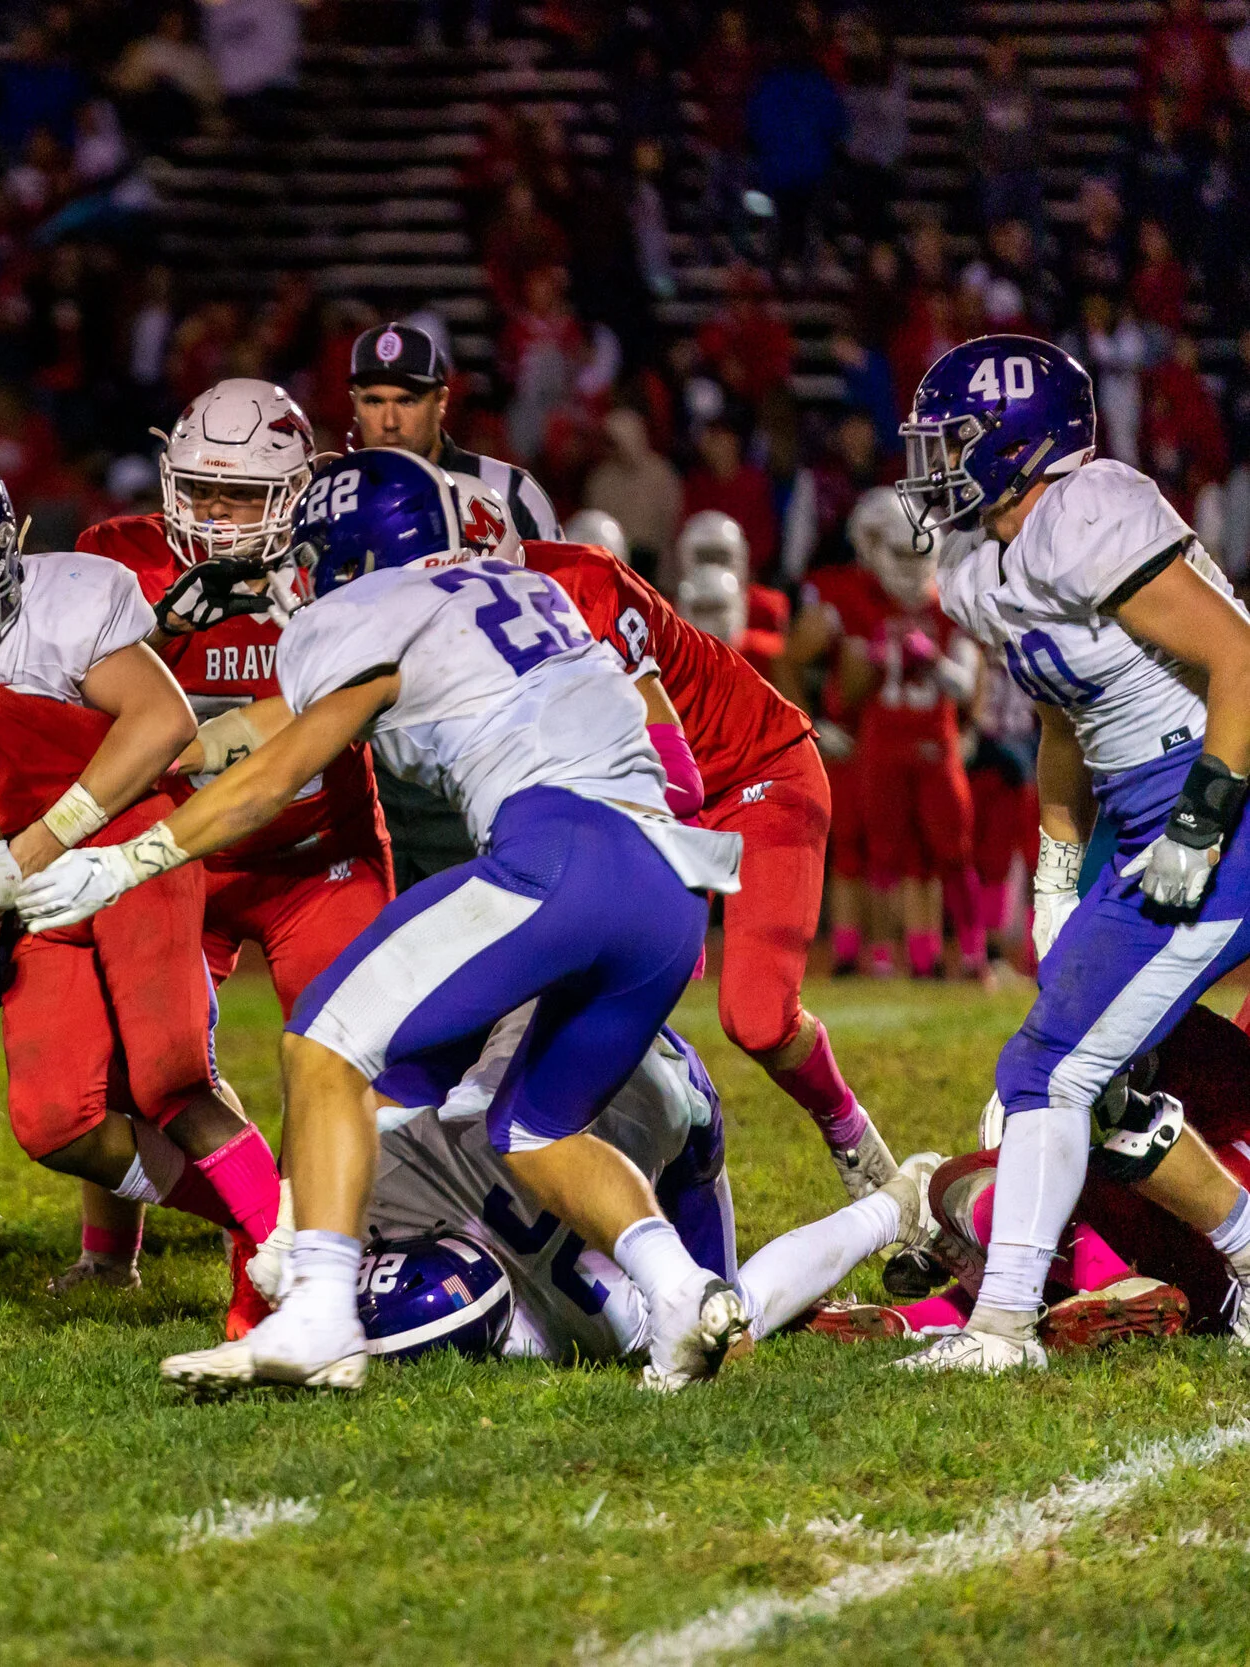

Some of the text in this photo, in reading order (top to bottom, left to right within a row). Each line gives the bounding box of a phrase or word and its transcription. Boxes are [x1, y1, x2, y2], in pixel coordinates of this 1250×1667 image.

[968, 356, 1034, 401] 40
[306, 469, 361, 526] 22
[430, 560, 592, 677] 22
[205, 645, 277, 681] BRAV
[1168, 732, 1186, 746] XL
